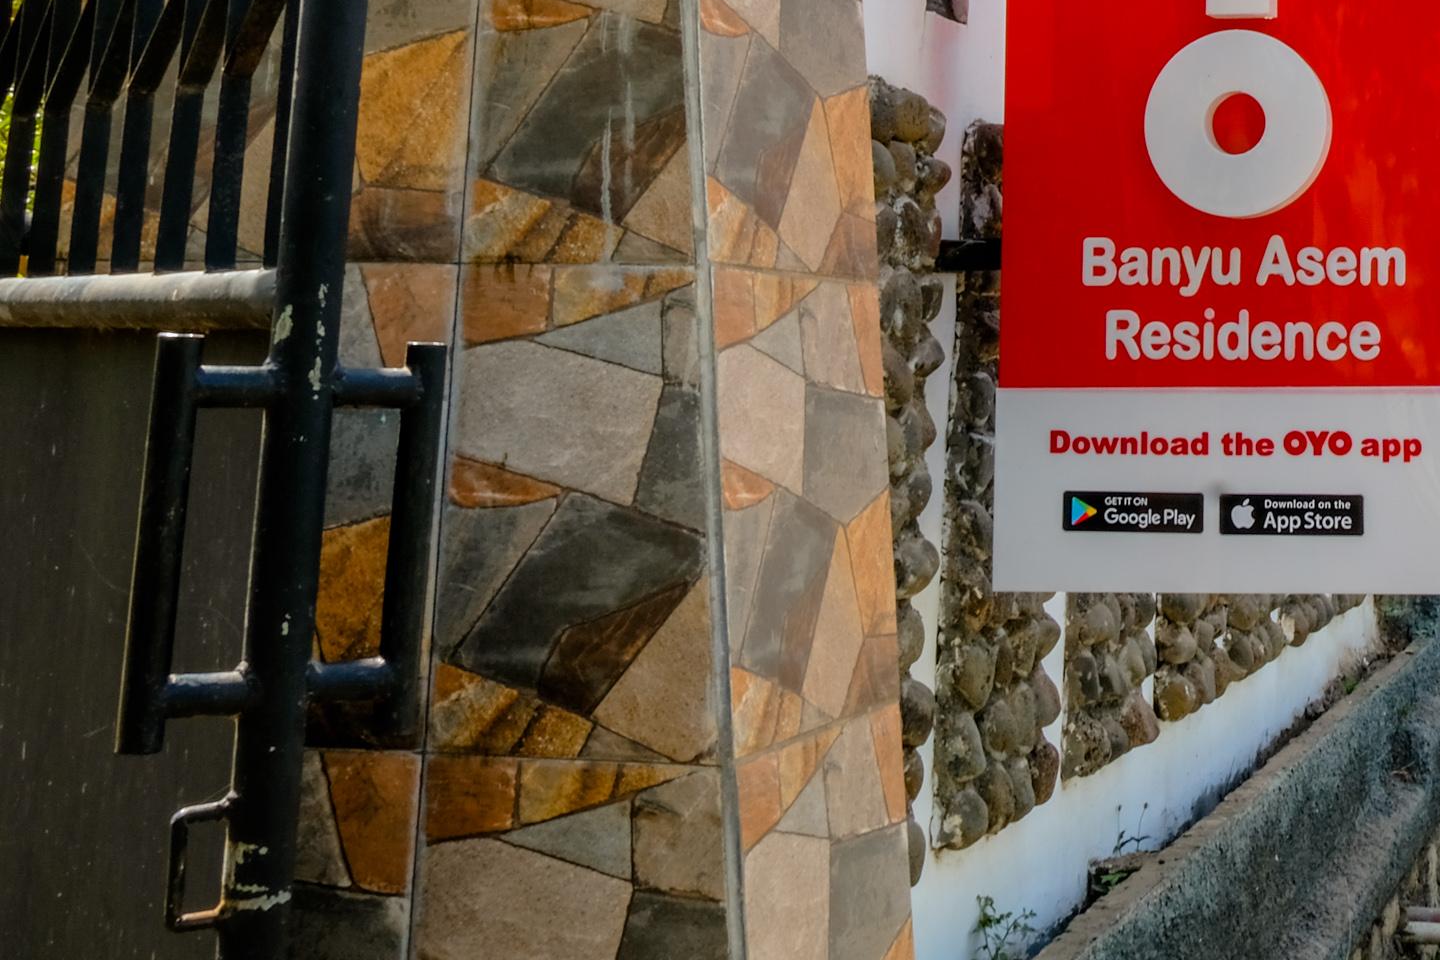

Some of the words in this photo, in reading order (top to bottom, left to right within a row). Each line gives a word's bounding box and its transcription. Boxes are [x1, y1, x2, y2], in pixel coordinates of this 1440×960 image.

[1082, 237, 1241, 297] Banyu
[1256, 235, 1406, 286] Asem
[1105, 308, 1381, 361] Residence
[1049, 430, 1210, 456] Download
[1221, 432, 1275, 457] the
[1283, 431, 1353, 456] OYO
[1360, 437, 1423, 463] app
[1104, 496, 1122, 506] GET
[1124, 497, 1132, 506] IT
[1133, 497, 1148, 506] ON
[1264, 499, 1315, 509] Download
[1318, 501, 1331, 509] on
[1334, 499, 1351, 510] the
[1104, 508, 1161, 529] Google
[1164, 509, 1196, 530] Play
[1263, 511, 1301, 533] App
[1304, 512, 1352, 530] Store
